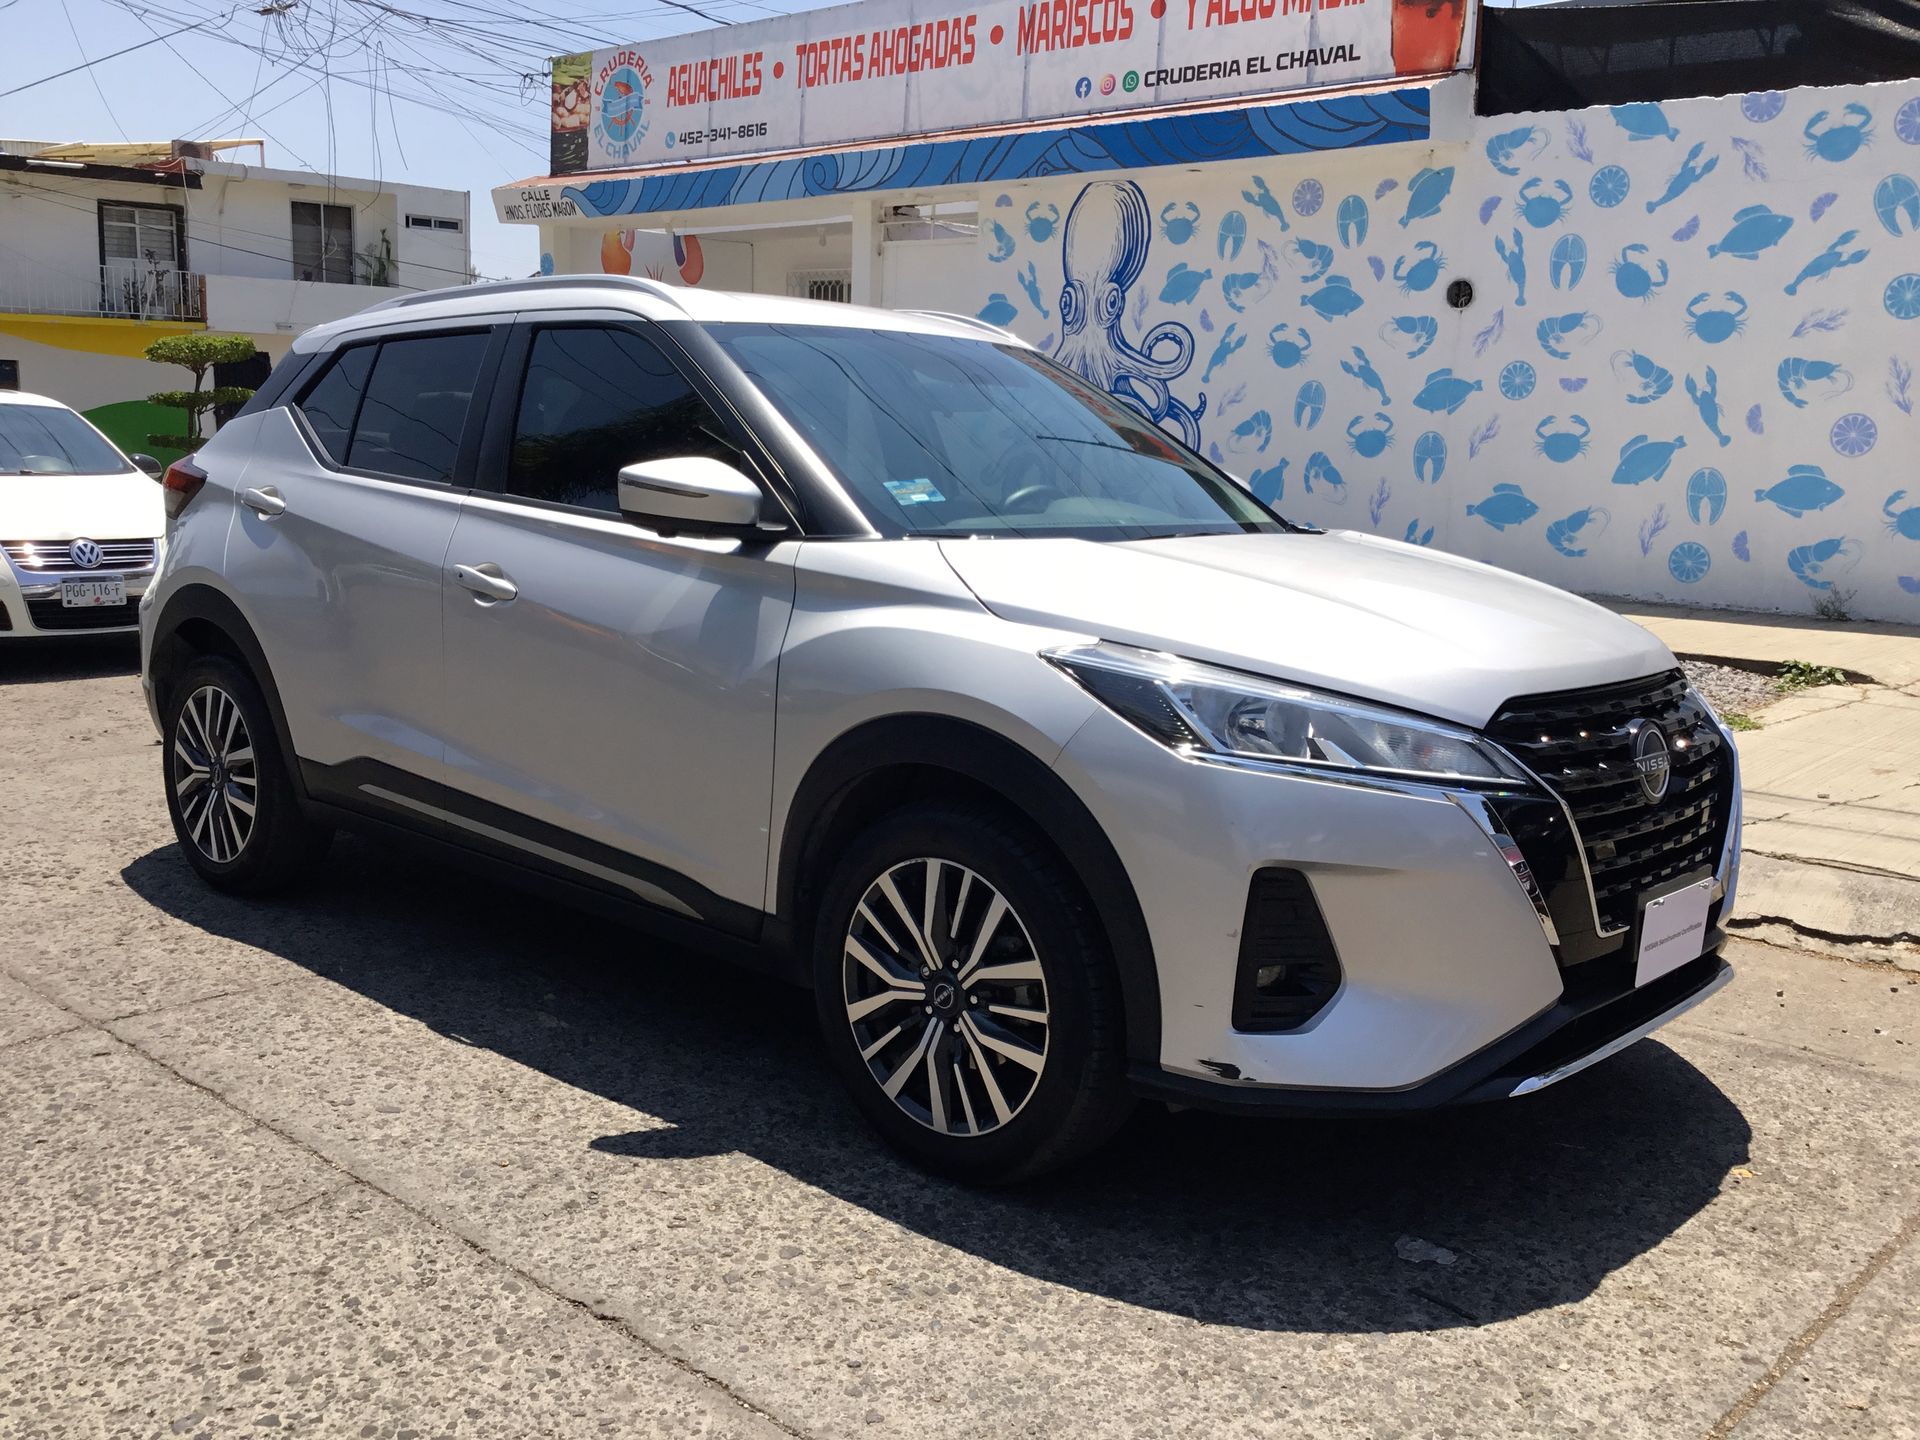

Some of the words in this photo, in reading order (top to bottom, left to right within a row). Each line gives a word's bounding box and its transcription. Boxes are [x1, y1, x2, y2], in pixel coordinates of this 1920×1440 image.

[594, 51, 653, 97] CRUDERIA
[666, 51, 763, 108] AGUACHILES
[796, 34, 865, 89] TORTAS
[868, 15, 977, 79] AHOGADAS
[1016, 0, 1134, 56] MARISCOS
[1144, 60, 1241, 87] CRUDERIA
[1246, 56, 1271, 75] EL
[1276, 44, 1361, 70] CHAVAL
[594, 124, 605, 149] EL
[605, 119, 650, 159] CHAVAL
[679, 122, 767, 145] 452-341-8616
[521, 190, 551, 202] CALLE
[525, 202, 552, 219] FLORES
[551, 201, 577, 217] MAGON
